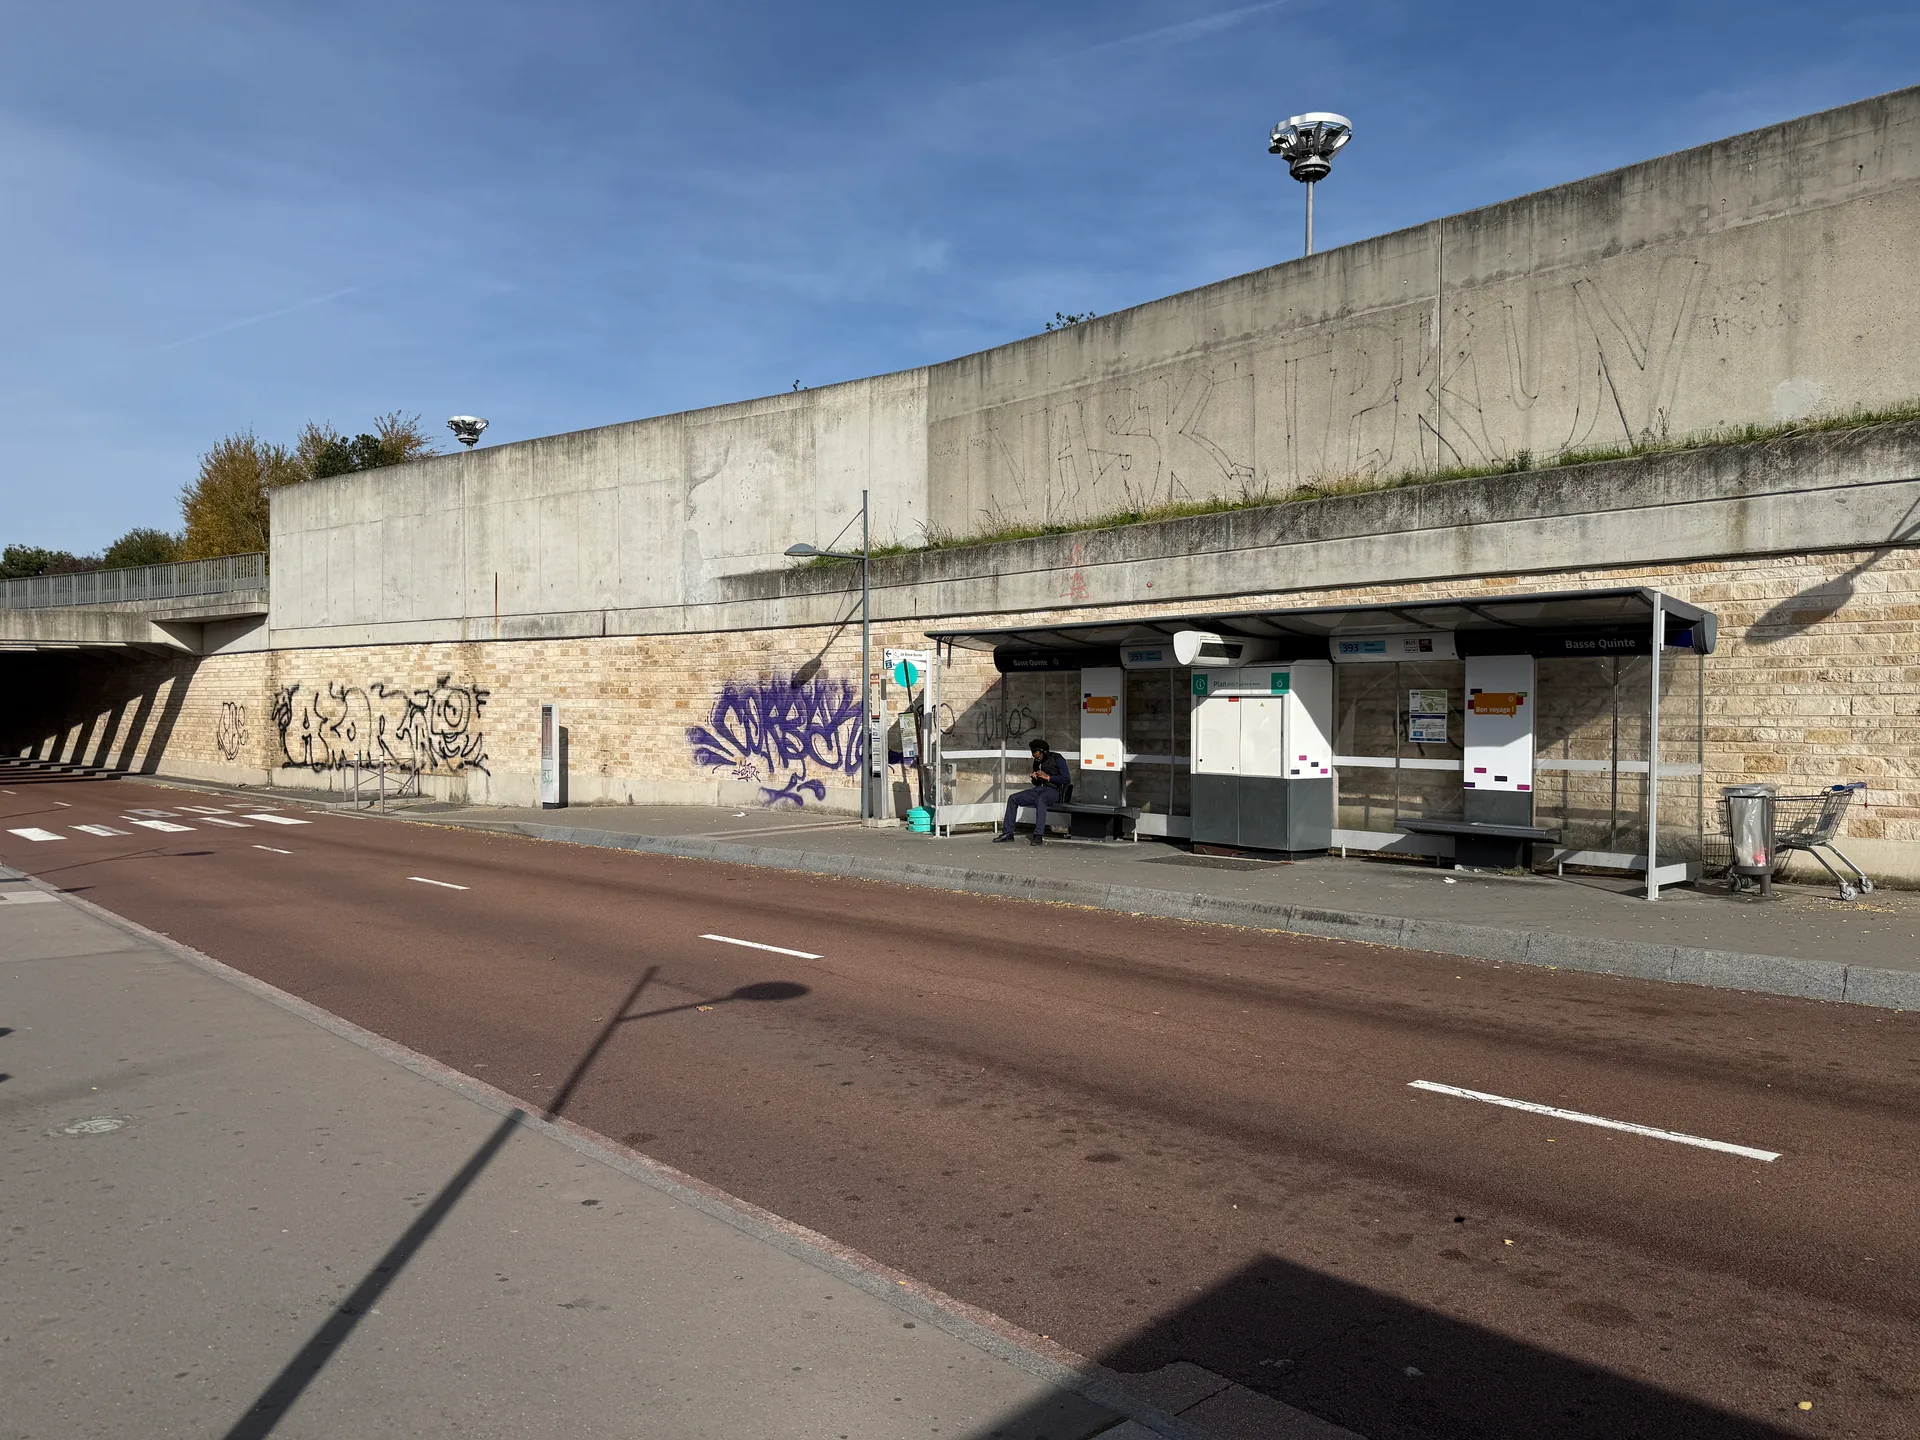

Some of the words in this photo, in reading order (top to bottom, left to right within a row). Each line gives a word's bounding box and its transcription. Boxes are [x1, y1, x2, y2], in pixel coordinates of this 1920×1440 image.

[1342, 643, 1359, 652] 393
[1565, 640, 1596, 649] Basse
[1598, 638, 1636, 649] Quinte
[1130, 652, 1143, 661] 393
[1013, 659, 1029, 667] Basse
[1029, 659, 1048, 667] Quinte
[1213, 680, 1227, 688] Plan
